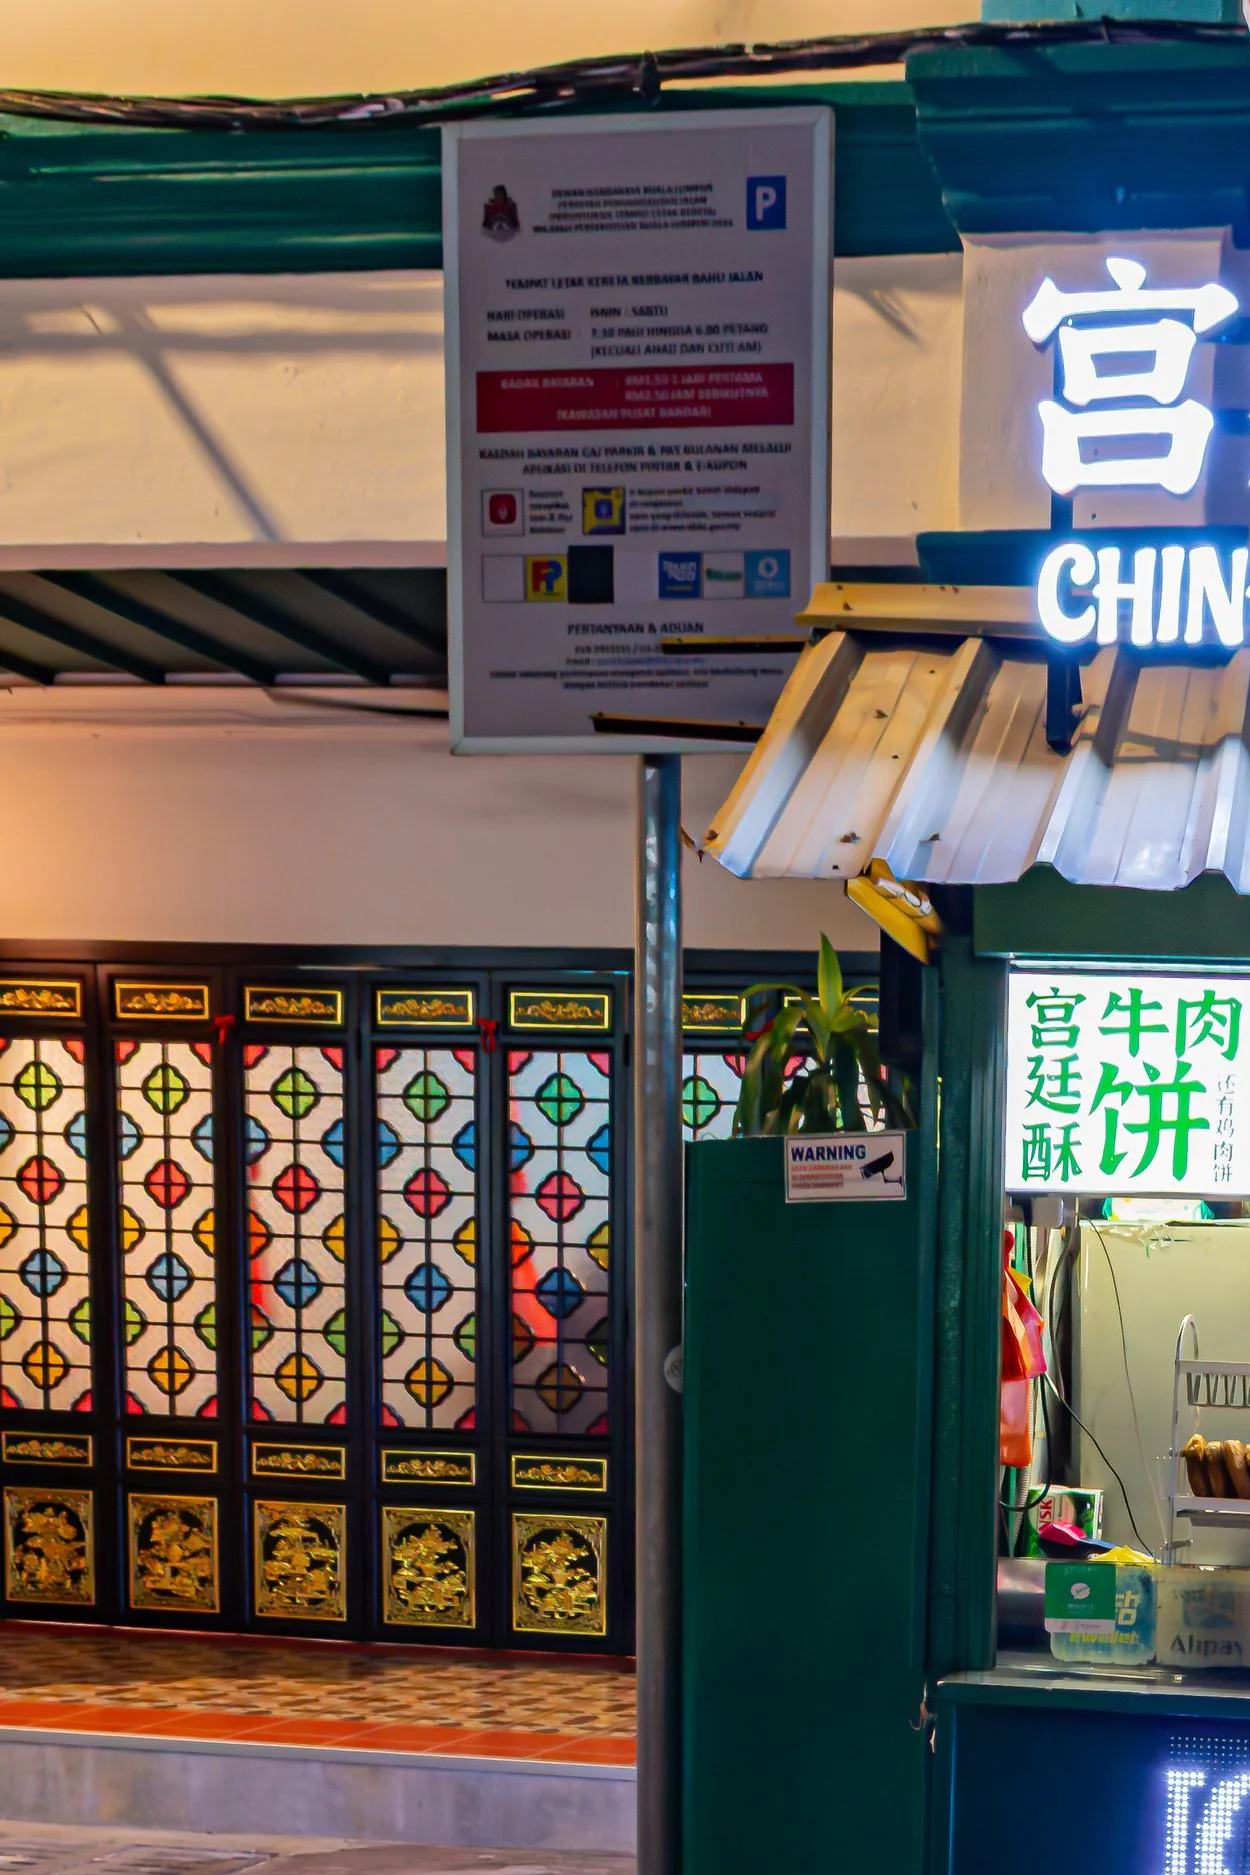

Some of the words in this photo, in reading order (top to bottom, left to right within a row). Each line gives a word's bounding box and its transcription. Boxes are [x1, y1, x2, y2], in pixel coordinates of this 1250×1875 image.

[1098, 988, 1242, 1062] 牛肉
[1021, 986, 1087, 1183] 宫廷酥
[1212, 1073, 1237, 1184] 还有鸡肉饼
[791, 1144, 866, 1162] WARNING
